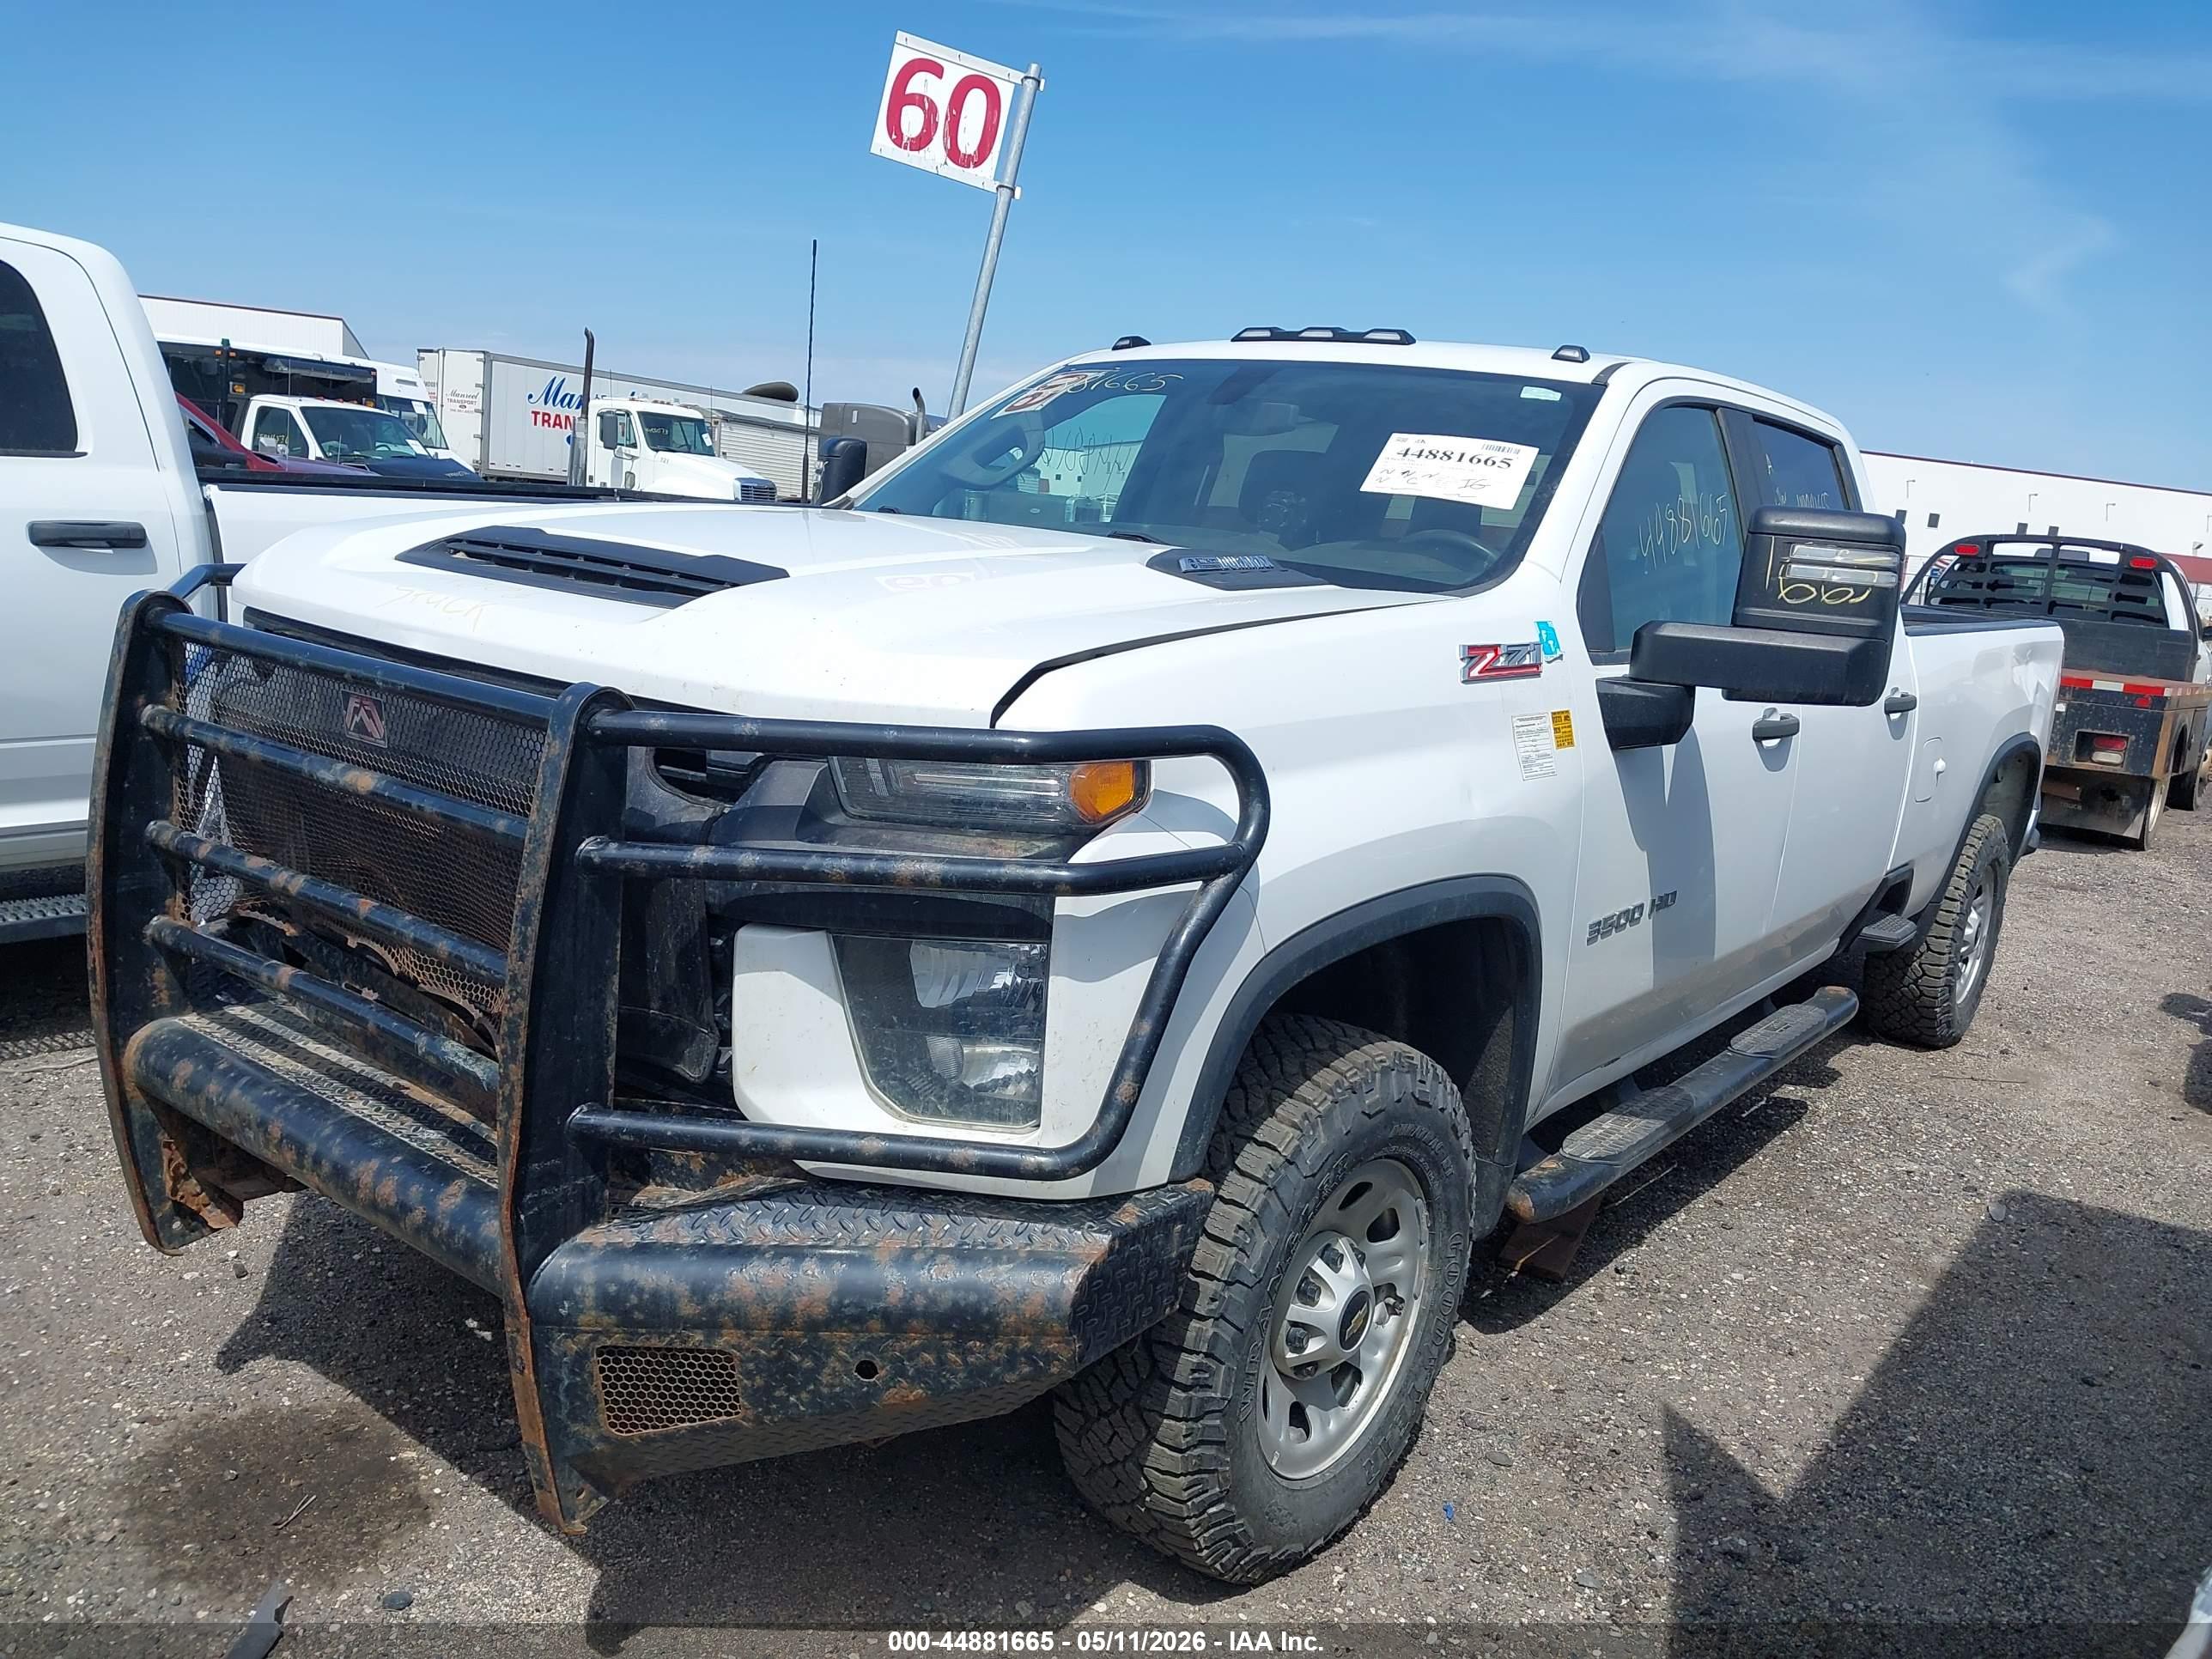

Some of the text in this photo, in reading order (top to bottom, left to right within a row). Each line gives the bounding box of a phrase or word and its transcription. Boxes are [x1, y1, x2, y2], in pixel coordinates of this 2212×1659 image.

[885, 58, 1002, 169] 60
[1395, 446, 1514, 470] 44881665
[1638, 491, 1729, 568] 44881665
[1459, 641, 1543, 685] Z71
[1586, 890, 1678, 946] 3500 HD
